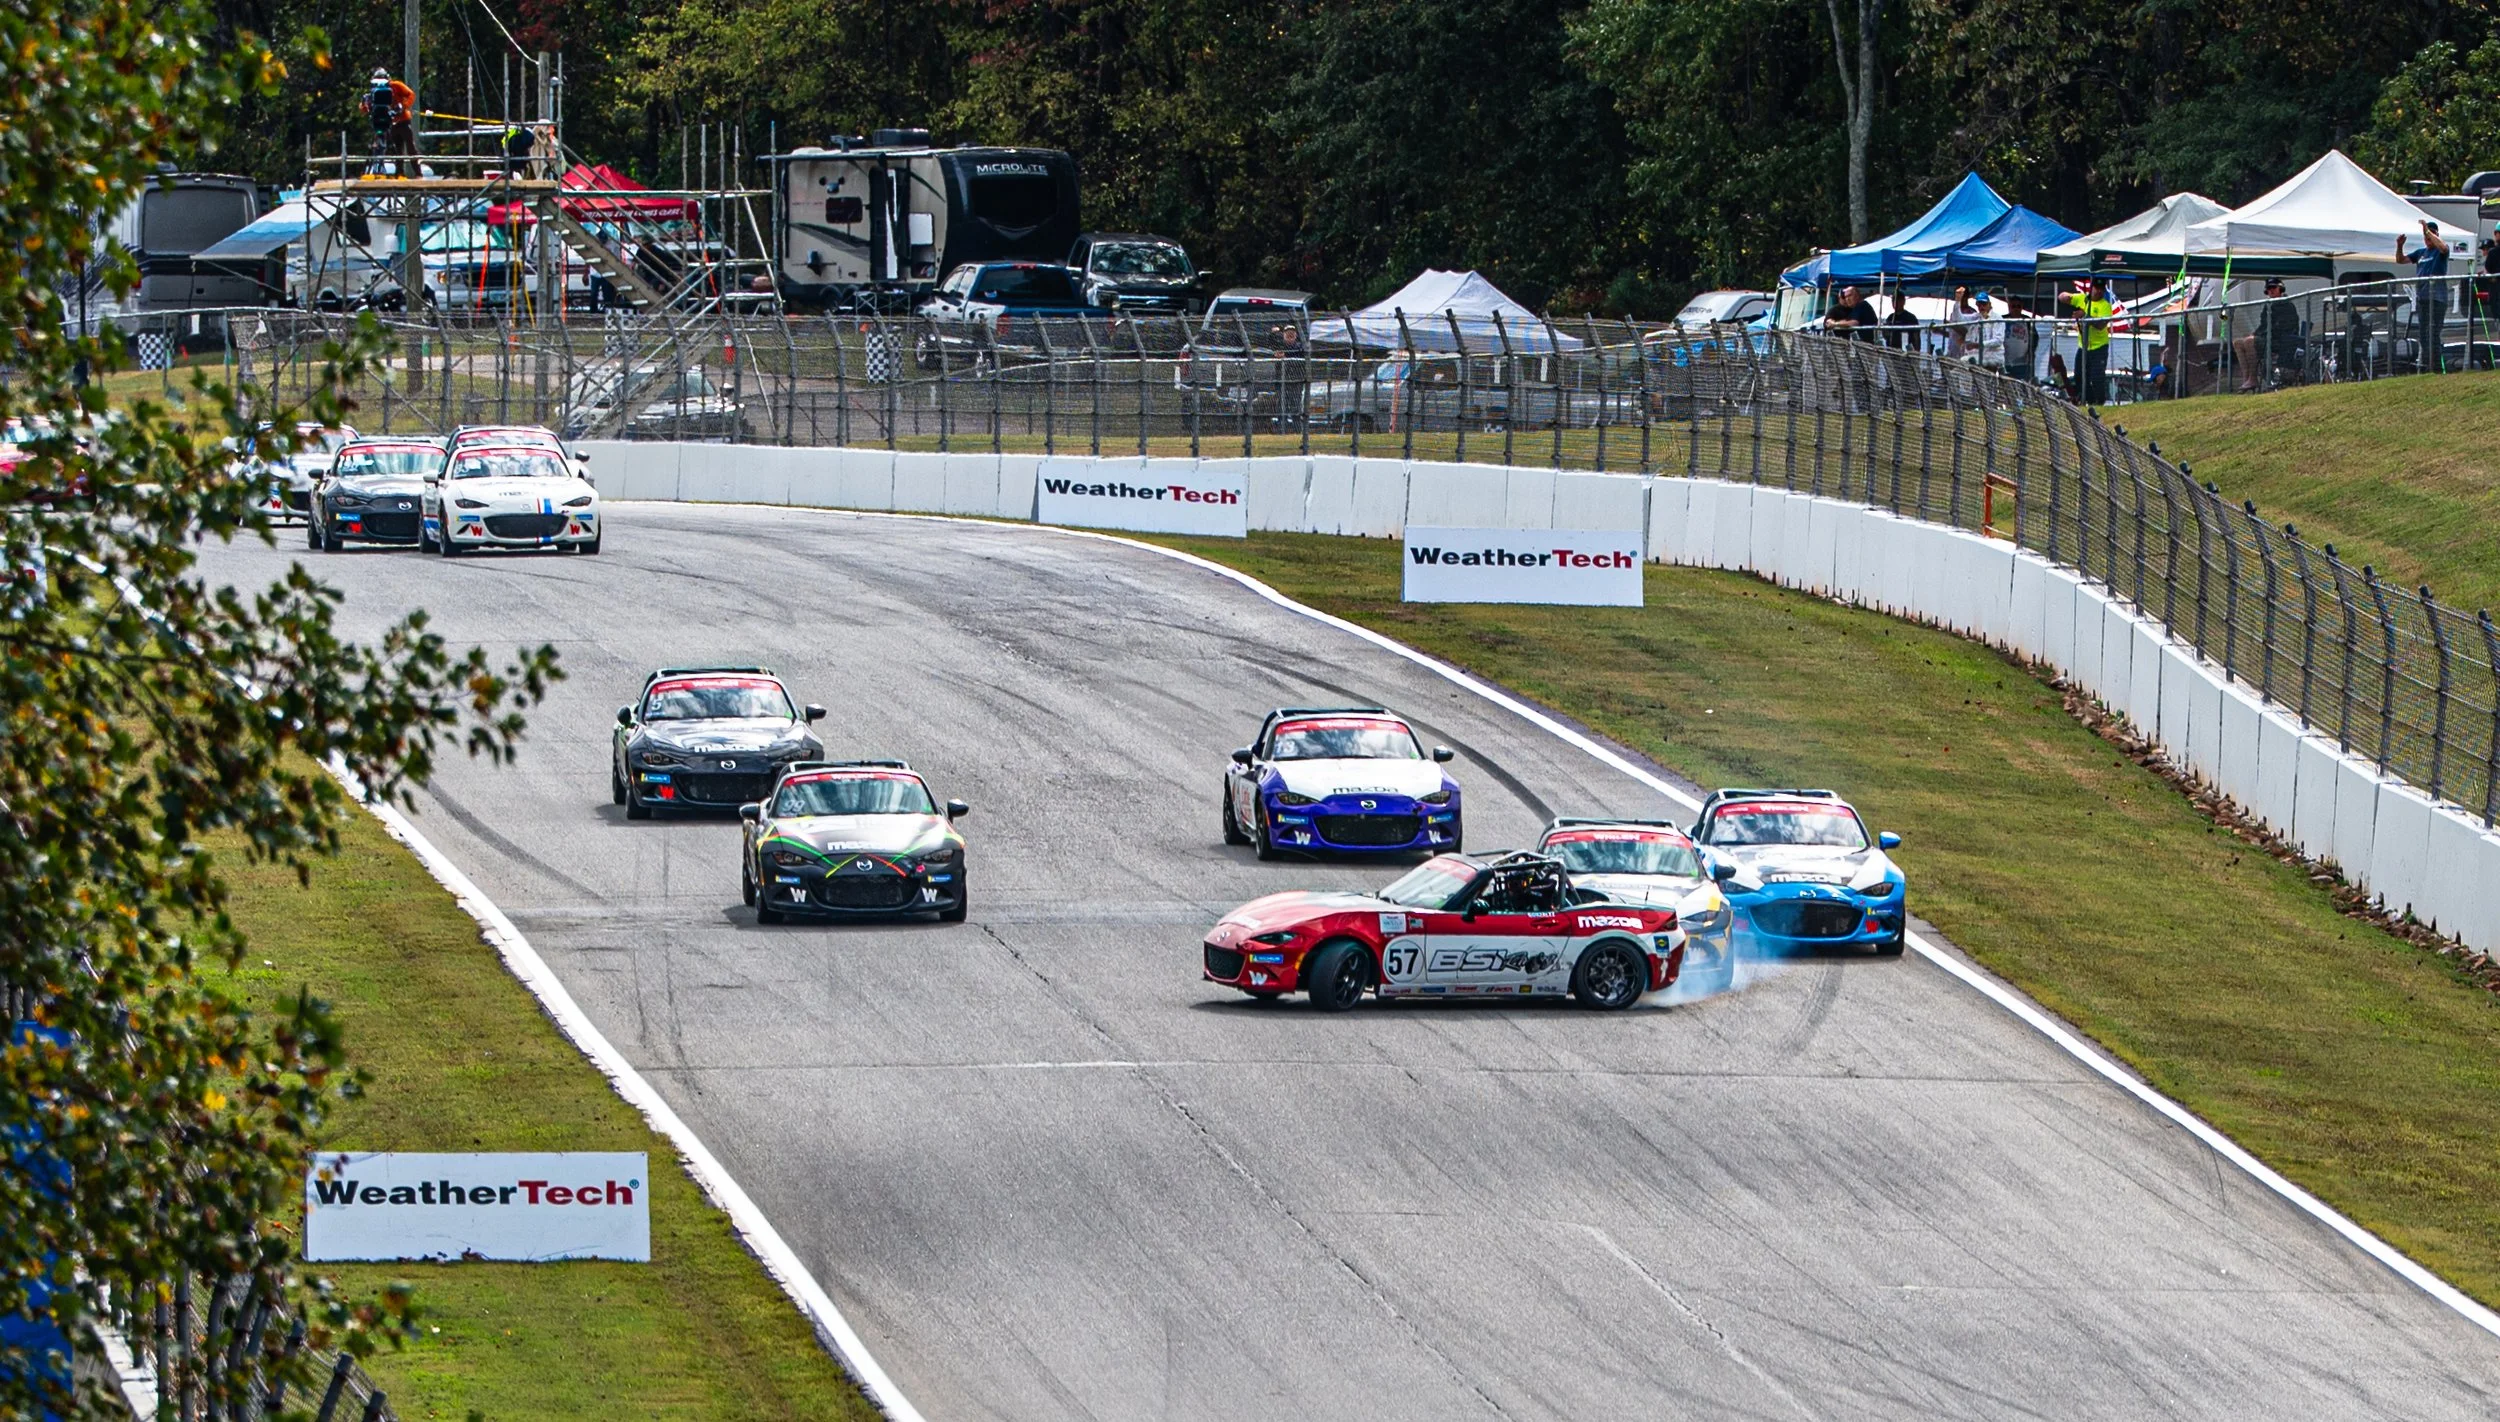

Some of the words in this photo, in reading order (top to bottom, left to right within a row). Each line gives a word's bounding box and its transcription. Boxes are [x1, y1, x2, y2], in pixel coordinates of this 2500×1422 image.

[651, 700, 662, 711] 5
[1294, 830, 1311, 845] W
[790, 887, 807, 903] W
[922, 887, 938, 903] W
[1577, 915, 1643, 929] mazda
[1388, 948, 1419, 976] 57
[1248, 970, 1269, 985] W
